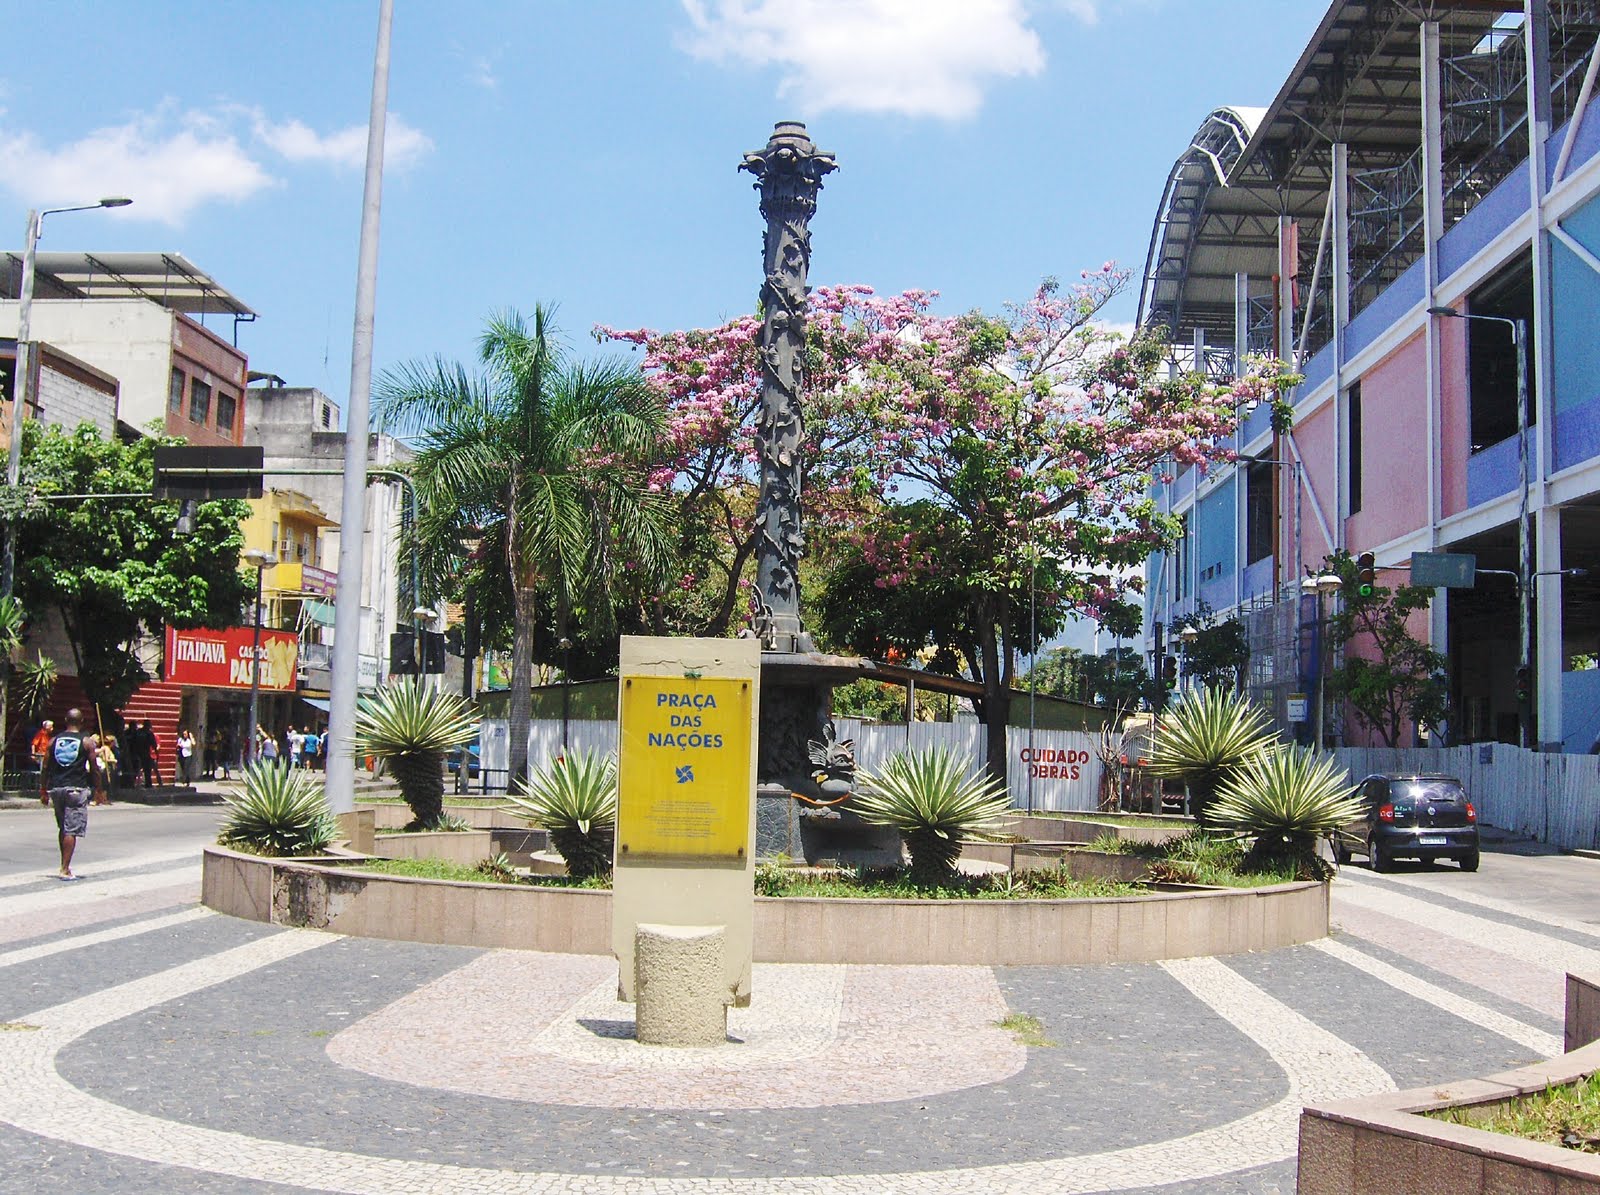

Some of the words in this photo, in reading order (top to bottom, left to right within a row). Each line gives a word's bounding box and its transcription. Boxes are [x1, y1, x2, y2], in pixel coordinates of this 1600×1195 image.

[177, 639, 226, 664] ITAIPAVA
[258, 646, 269, 660] DO
[657, 693, 716, 712] PRAÇA
[670, 715, 702, 728] DAS
[648, 730, 723, 751] NAÇÕES
[1020, 748, 1090, 765] CUIDADO
[1028, 764, 1080, 780] OBRAS
